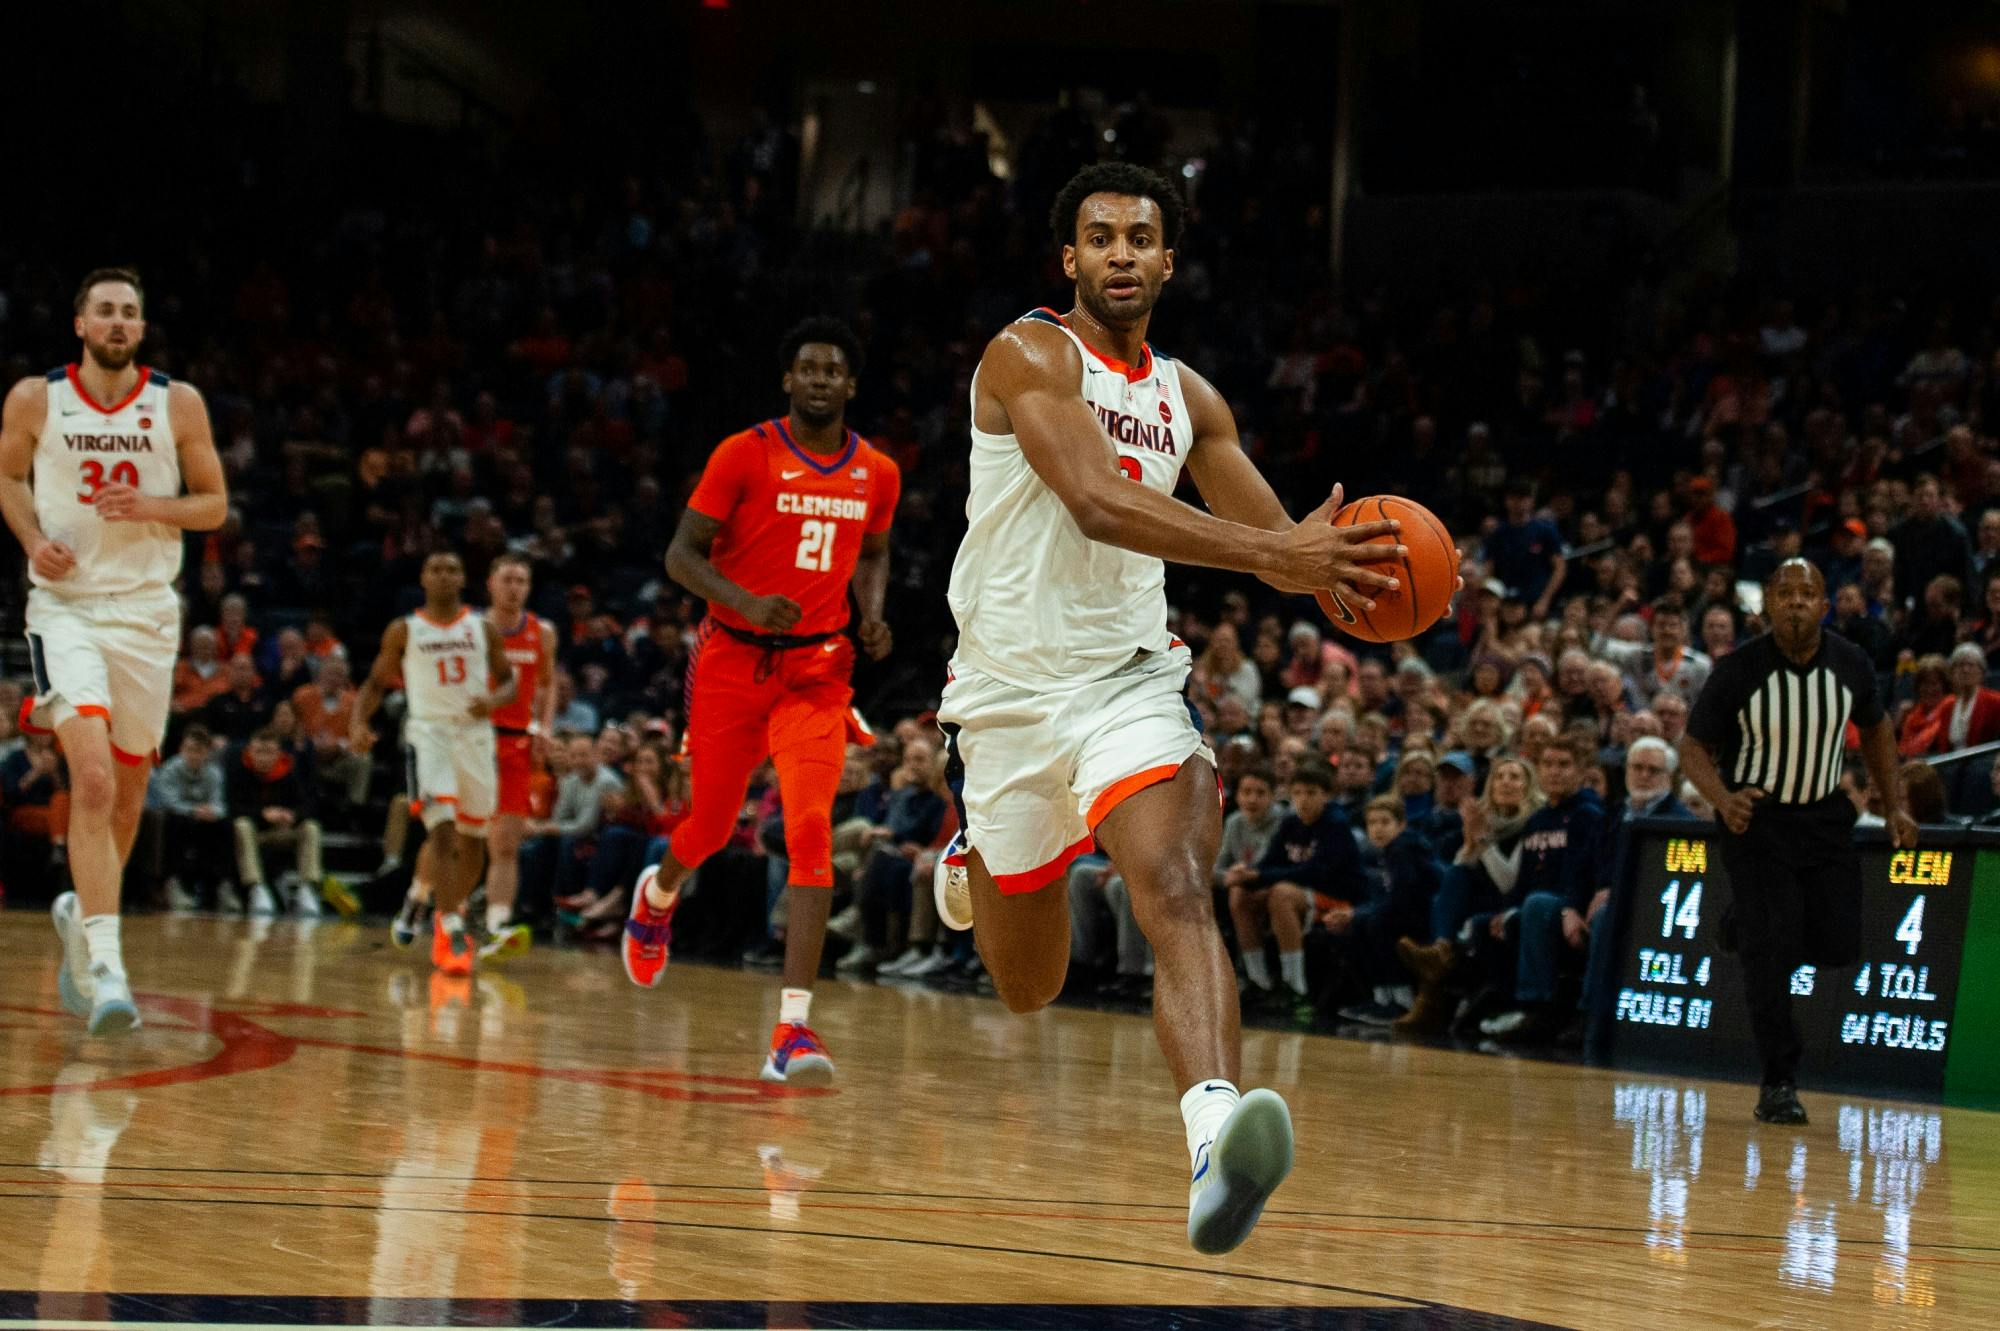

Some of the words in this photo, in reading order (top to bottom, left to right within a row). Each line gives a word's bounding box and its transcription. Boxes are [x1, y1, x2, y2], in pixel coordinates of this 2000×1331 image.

[63, 434, 153, 452] VIRGINIA
[776, 492, 868, 521] CLEMSON
[795, 519, 837, 572] 21
[436, 655, 466, 686] 13
[1889, 850, 1953, 886] CLEM
[1660, 879, 1704, 939] 14
[1895, 894, 1926, 955] 4
[1694, 956, 1711, 987] 4
[1854, 962, 1871, 996] 4
[1616, 988, 1684, 1026] FOULS
[1870, 1012, 1948, 1051] FOULS
